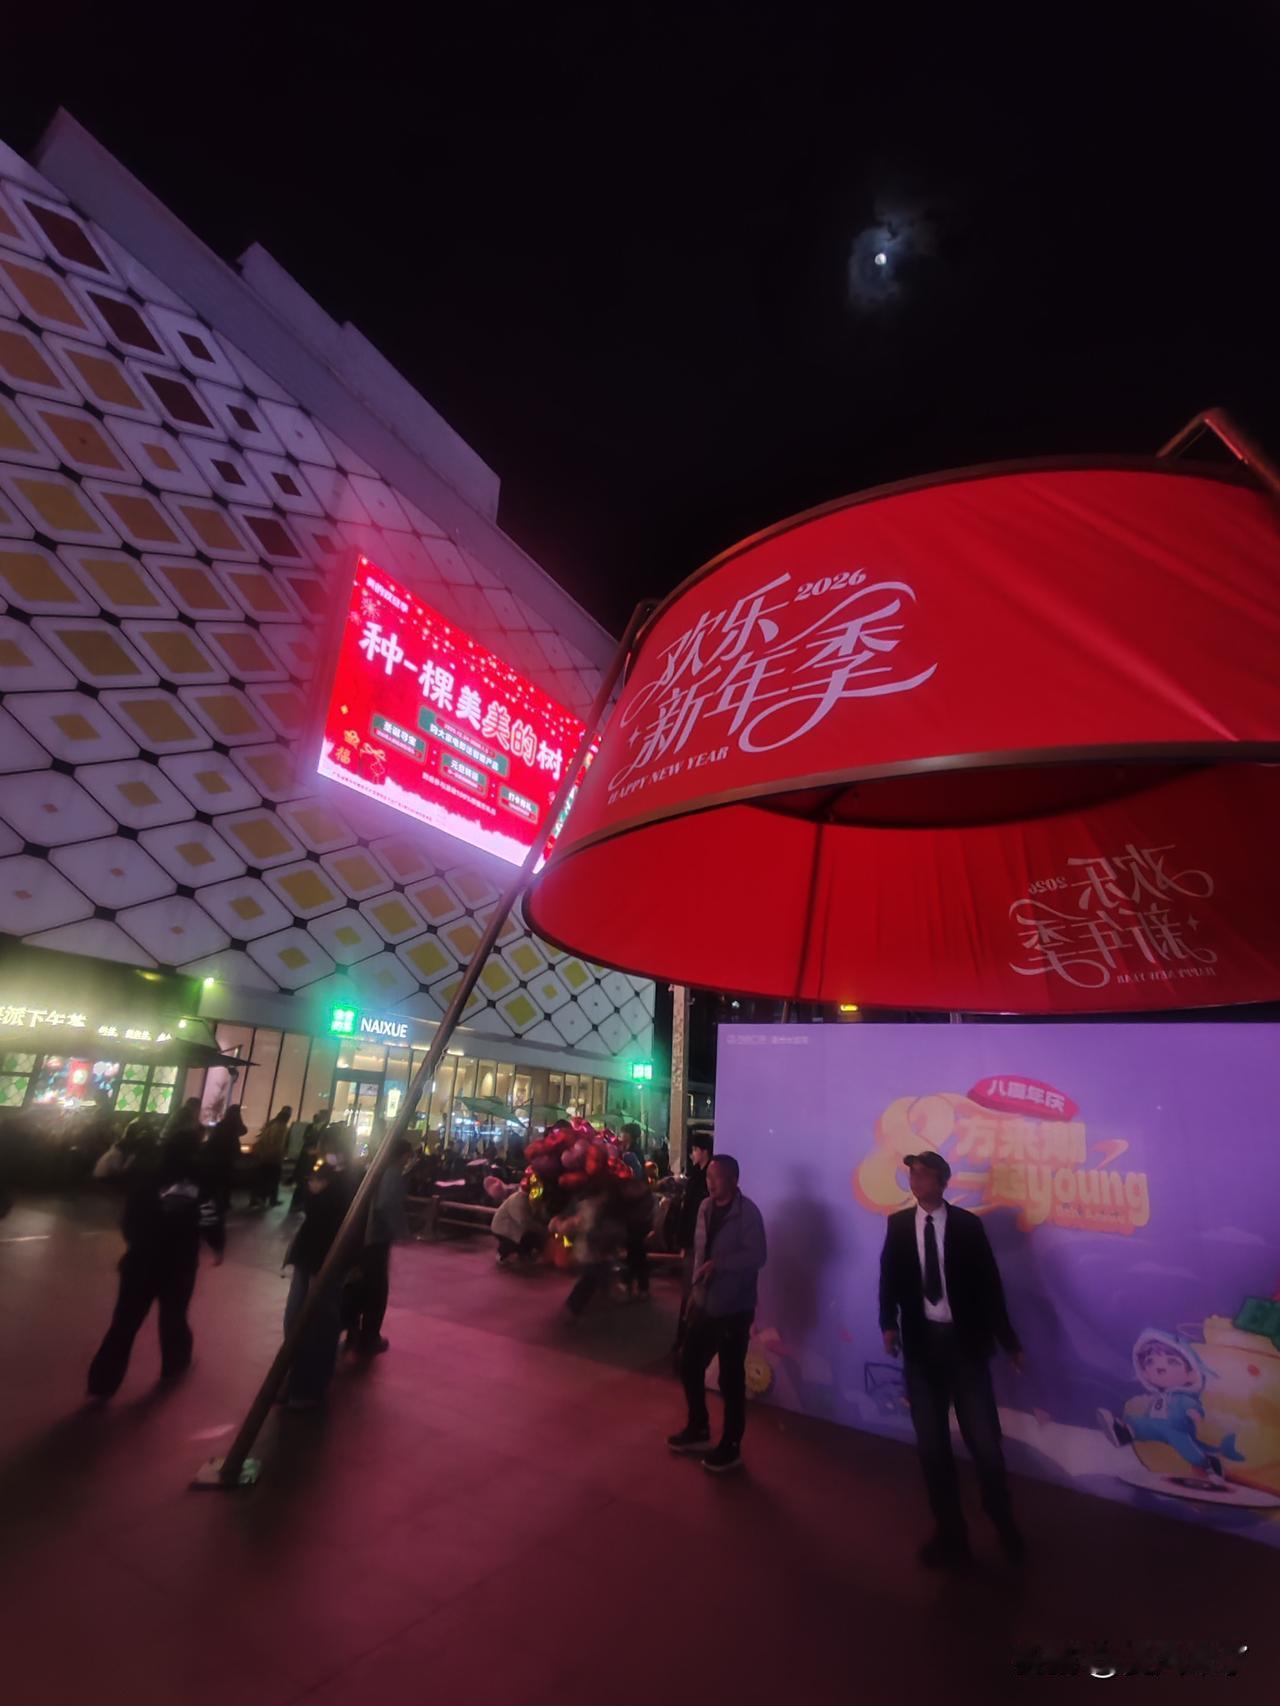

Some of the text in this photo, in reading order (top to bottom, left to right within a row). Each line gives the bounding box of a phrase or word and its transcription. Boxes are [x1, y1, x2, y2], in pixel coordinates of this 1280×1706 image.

[619, 567, 868, 727] 欢乐 2026
[358, 622, 563, 781] 种一棵美美的树
[608, 581, 938, 791] 新年季
[335, 746, 352, 765] 福
[607, 745, 730, 805] HAPPY NEW YEAR
[360, 1017, 408, 1039] NAIXUE
[986, 1078, 1066, 1114] 八周年庆
